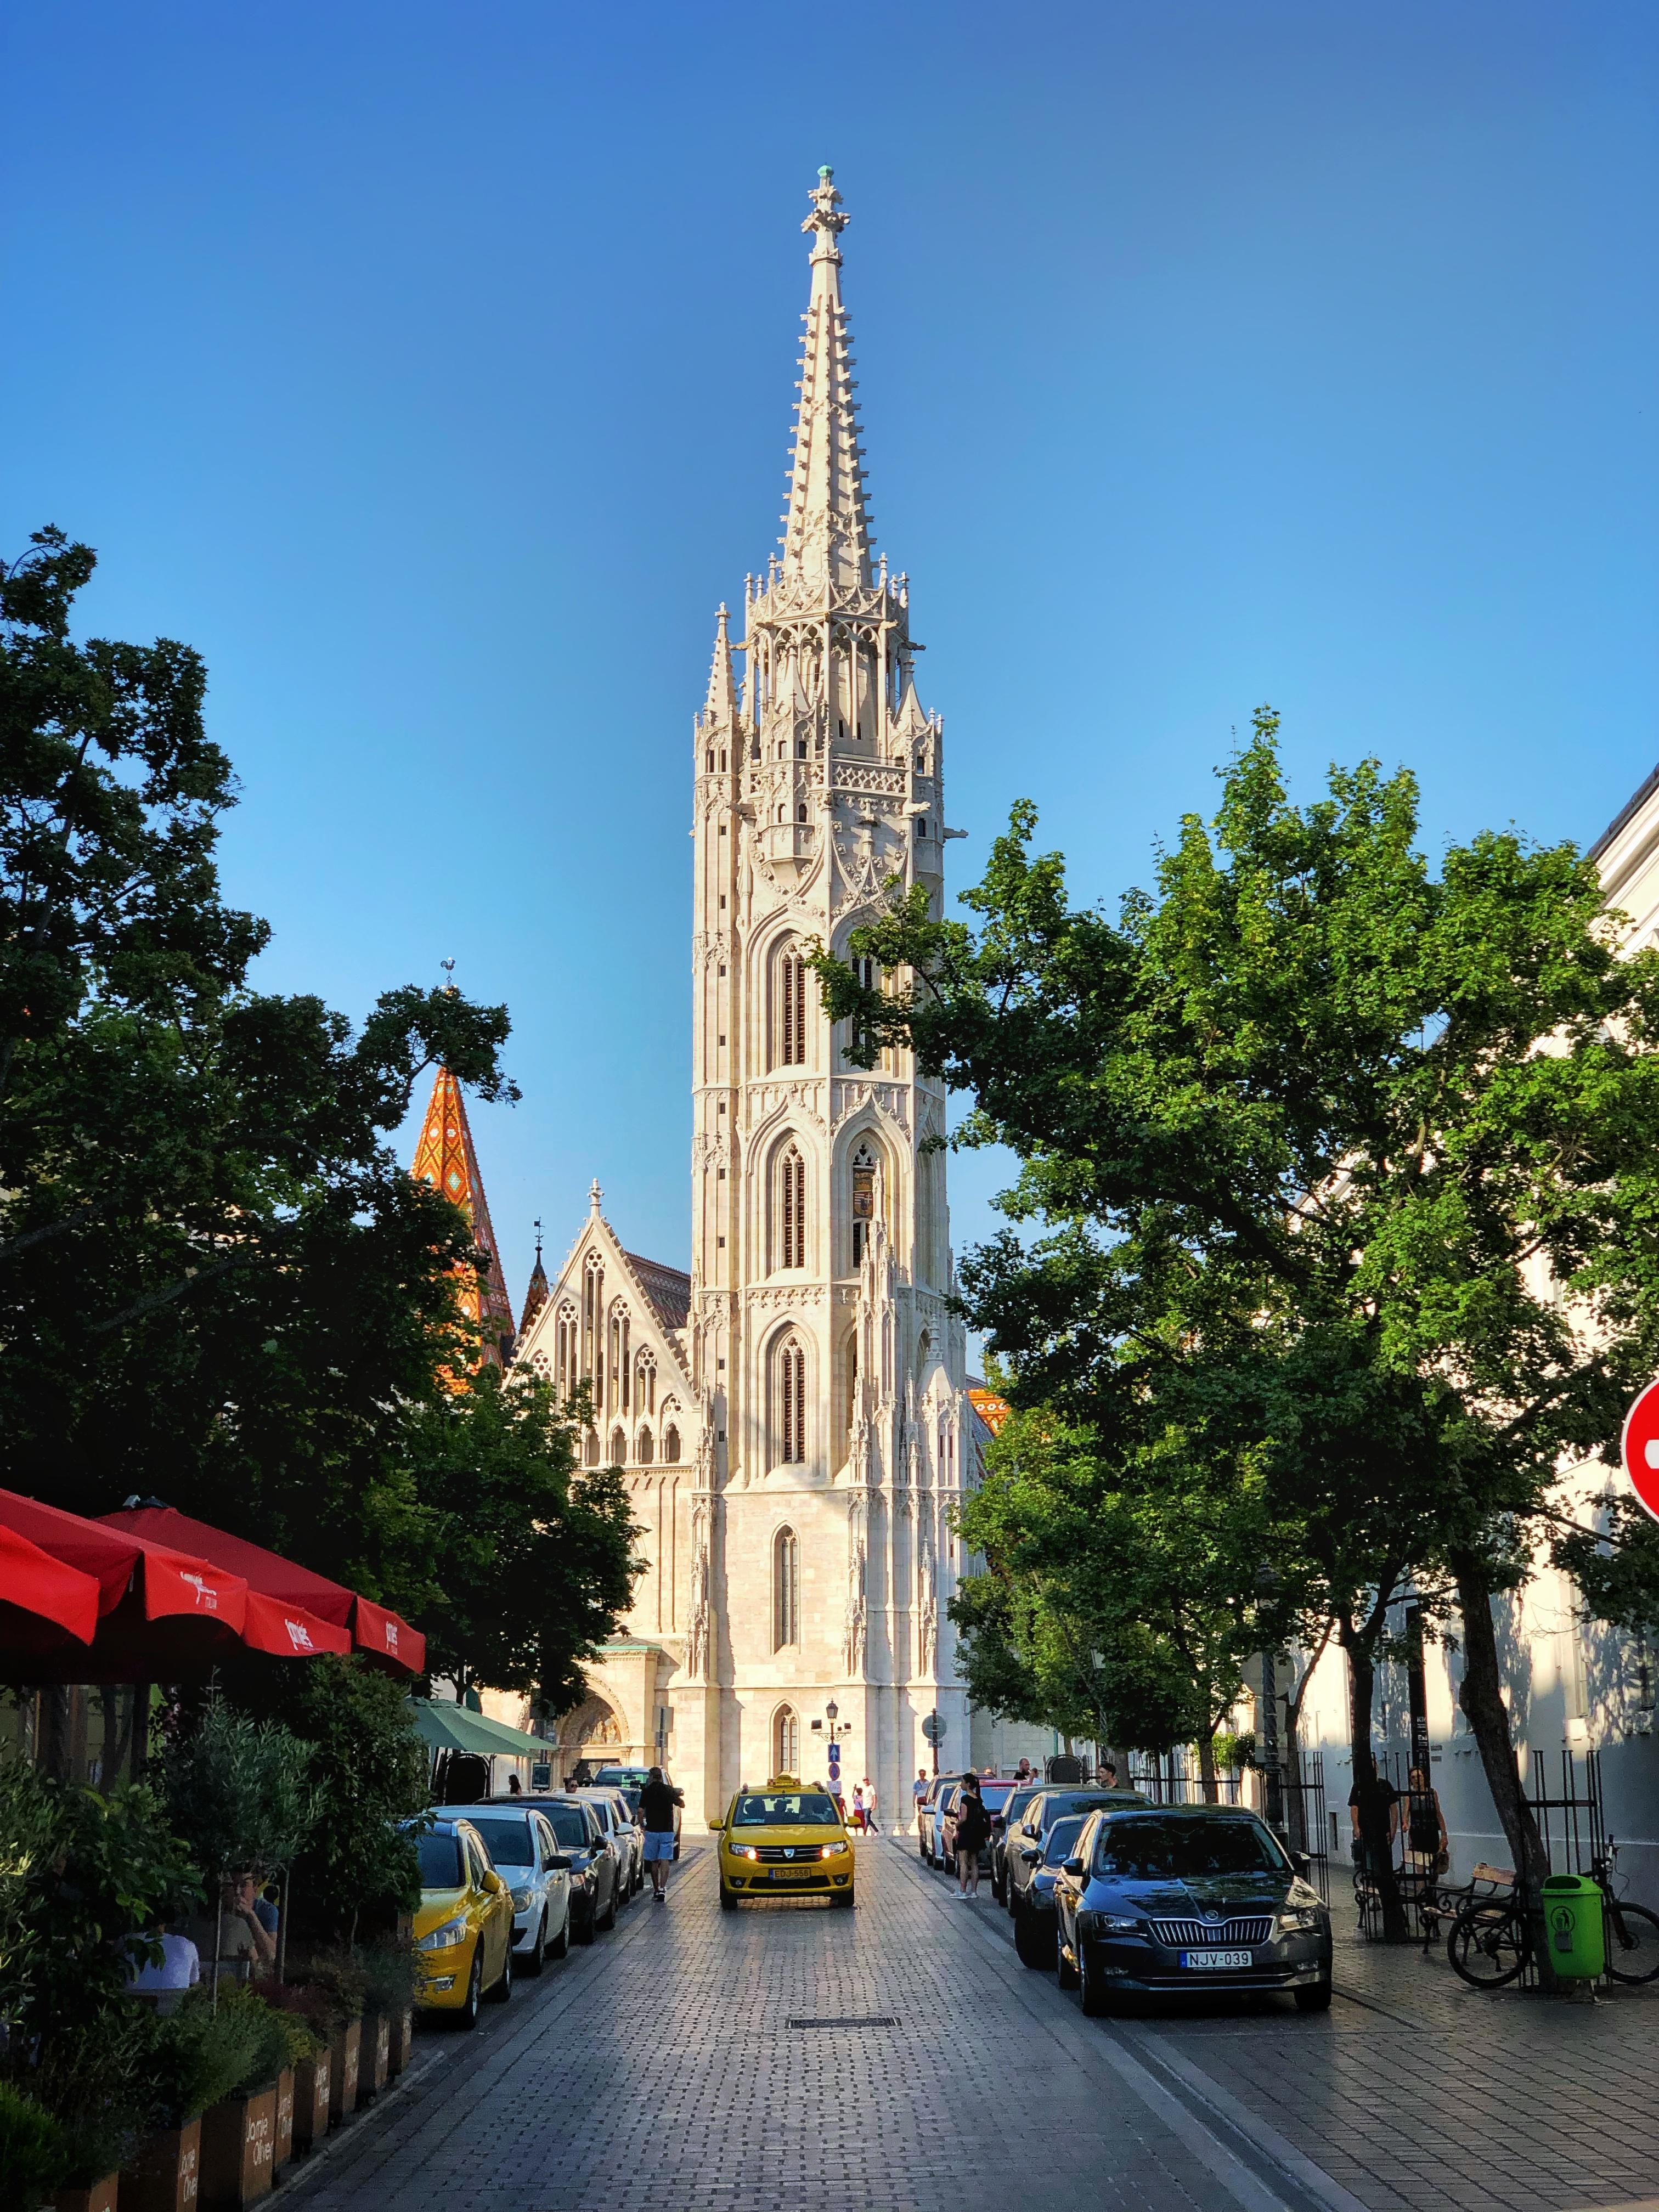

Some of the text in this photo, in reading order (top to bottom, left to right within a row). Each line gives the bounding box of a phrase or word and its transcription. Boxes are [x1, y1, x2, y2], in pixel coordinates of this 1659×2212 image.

[1189, 1953, 1249, 1966] NJV-039
[246, 2112, 268, 2143] Jamie
[253, 2140, 274, 2166] Oliver
